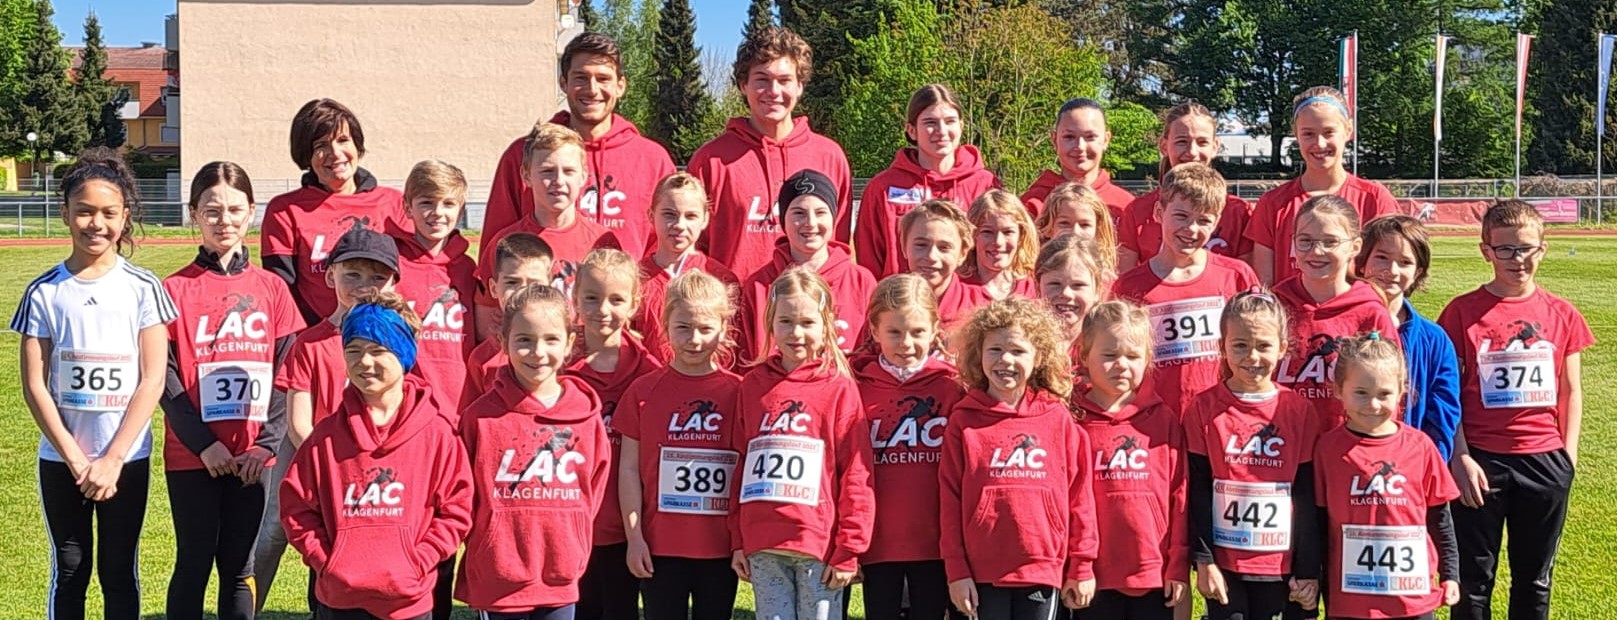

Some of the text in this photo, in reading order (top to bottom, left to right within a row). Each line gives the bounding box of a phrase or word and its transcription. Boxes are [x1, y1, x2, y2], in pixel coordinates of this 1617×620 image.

[580, 189, 627, 216] AC
[407, 300, 468, 330] AC
[195, 311, 268, 343] LAC
[1162, 313, 1214, 341] 391
[196, 341, 270, 358] KLAGENFURT
[70, 366, 122, 391] 365
[1494, 365, 1543, 390] 374
[104, 394, 129, 407] KLC
[215, 378, 262, 401] 370
[667, 412, 723, 432] LAC
[759, 412, 812, 432] LAC
[870, 416, 948, 448] LAC
[668, 432, 722, 441] KLAGENFURT
[1225, 434, 1285, 458] LAC
[494, 448, 587, 484] LAC
[752, 453, 805, 481] 420
[990, 447, 1048, 469] LAC
[1094, 448, 1149, 470] LAC
[1225, 455, 1284, 469] KLAGENFURT
[674, 466, 727, 493] 389
[989, 469, 1047, 479] KLAGENFURT
[1350, 474, 1408, 496] LAC
[343, 481, 406, 506] LAC
[493, 486, 582, 501] KLAGENFURT
[783, 483, 810, 500] KLC
[1350, 497, 1409, 507] KLAGENFURT
[342, 507, 404, 518] KLAGENFURT
[1223, 501, 1279, 529] 442
[1260, 531, 1285, 546] KLC
[1357, 545, 1415, 573] 443
[1399, 576, 1423, 591] KLC
